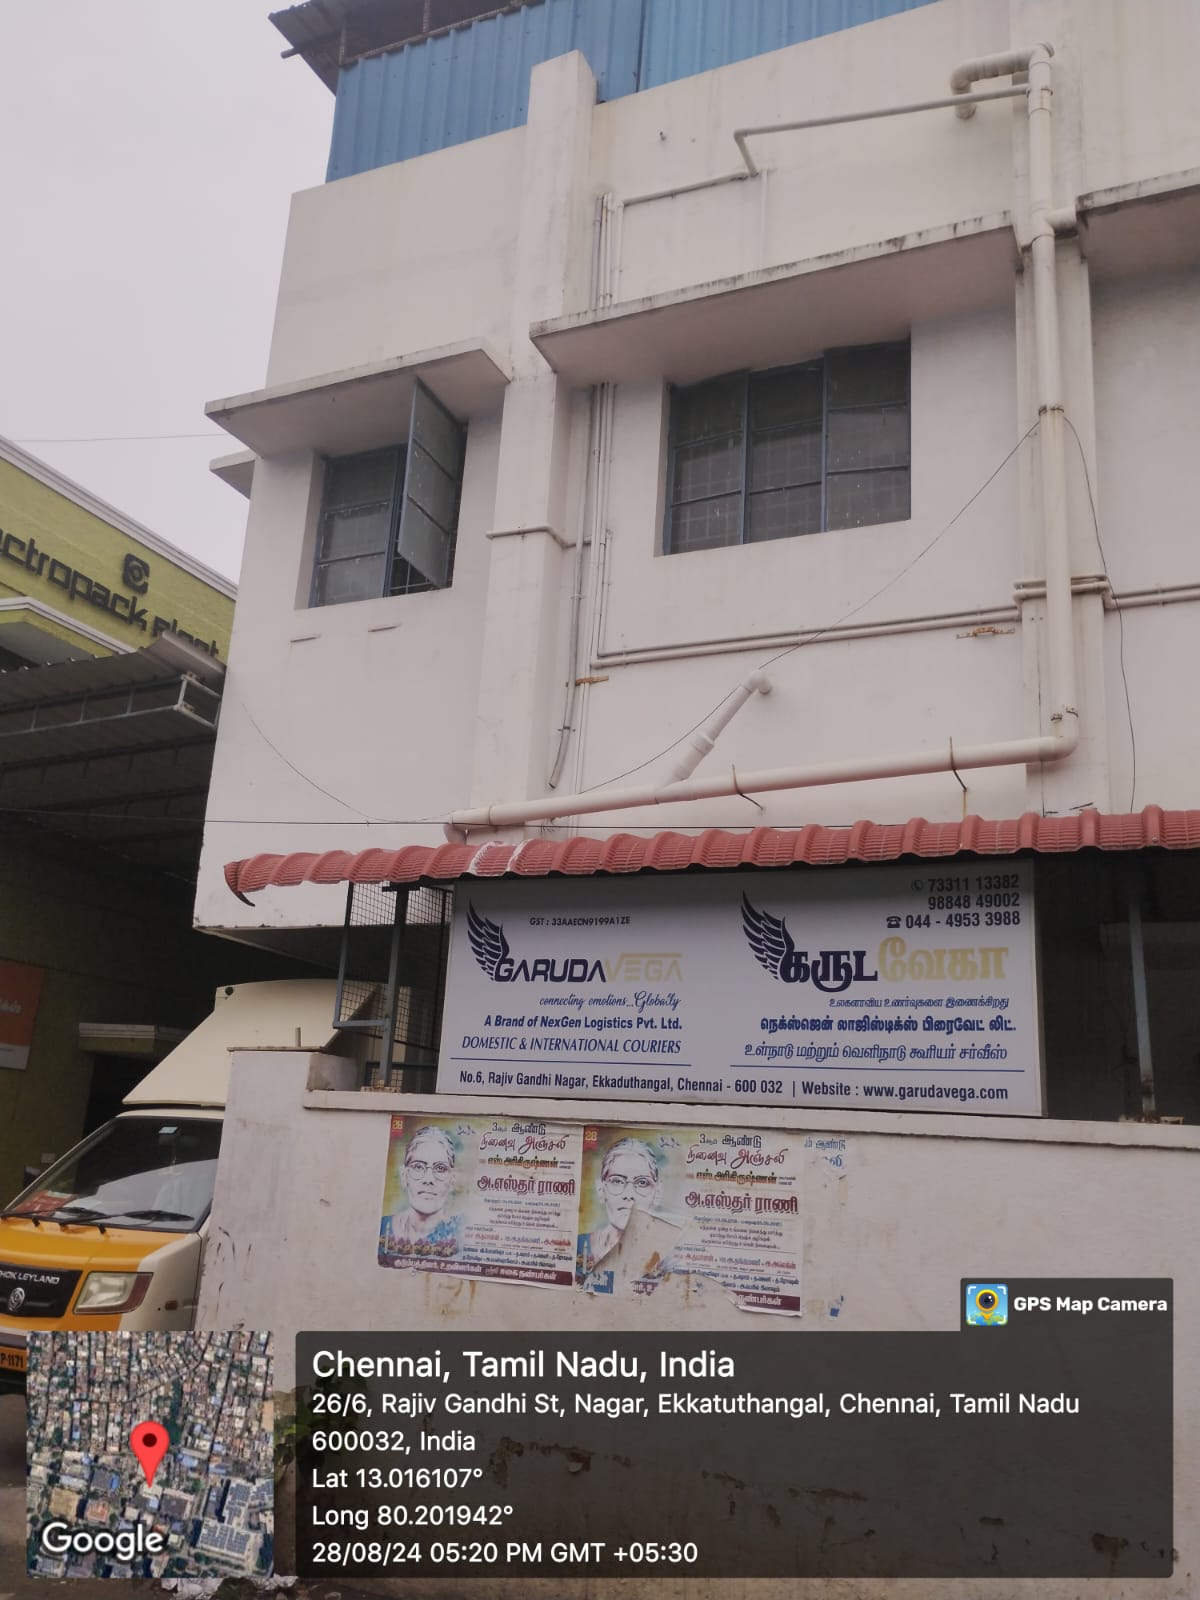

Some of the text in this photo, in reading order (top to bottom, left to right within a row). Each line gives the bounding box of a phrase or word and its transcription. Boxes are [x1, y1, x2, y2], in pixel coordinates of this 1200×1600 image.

[0, 528, 148, 632] ctropack
[928, 874, 1020, 893] 73311 13382
[928, 893, 1020, 911] 98848 49002
[529, 917, 545, 926] GST
[906, 914, 931, 929] 044
[946, 912, 980, 928] 4953
[985, 911, 1021, 926] 3988
[539, 993, 585, 1009] connecting
[484, 1015, 683, 1031] A Brand of NexGen Logistics Pvt. Ltd.
[760, 1014, 834, 1034] நெக்ஸ்ஜென்
[837, 1014, 918, 1034] லாஜிஸ்டிக்ஸ்
[922, 1015, 985, 1035] பிரைவேட்
[462, 1036, 682, 1054] DOMESTIC & INTERNATIONAL COURIERS
[745, 1040, 1008, 1063] உள்நாடு மற்றும் வெளிநாடு கூரியர் சர்வீஸ்
[459, 1070, 485, 1085] No.6,
[488, 1071, 513, 1087] Rajiv
[516, 1072, 551, 1086] Gandhi
[554, 1073, 589, 1089] Nagar,
[592, 1074, 673, 1092] Ekkaduthangal,
[677, 1077, 723, 1092] Chennai
[734, 1079, 757, 1093] 600
[760, 1079, 783, 1093] 032
[801, 1081, 851, 1096] Website
[863, 1083, 1009, 1101] www.garudavega.com
[518, 1134, 570, 1154] அஞ்சலி
[721, 1134, 762, 1149] ஆண்டு
[730, 1148, 789, 1169] அஞ்சலி
[538, 1178, 576, 1197] ராணி
[754, 1195, 799, 1215] ராணி
[0, 1270, 60, 1285] HOK LEYLAND
